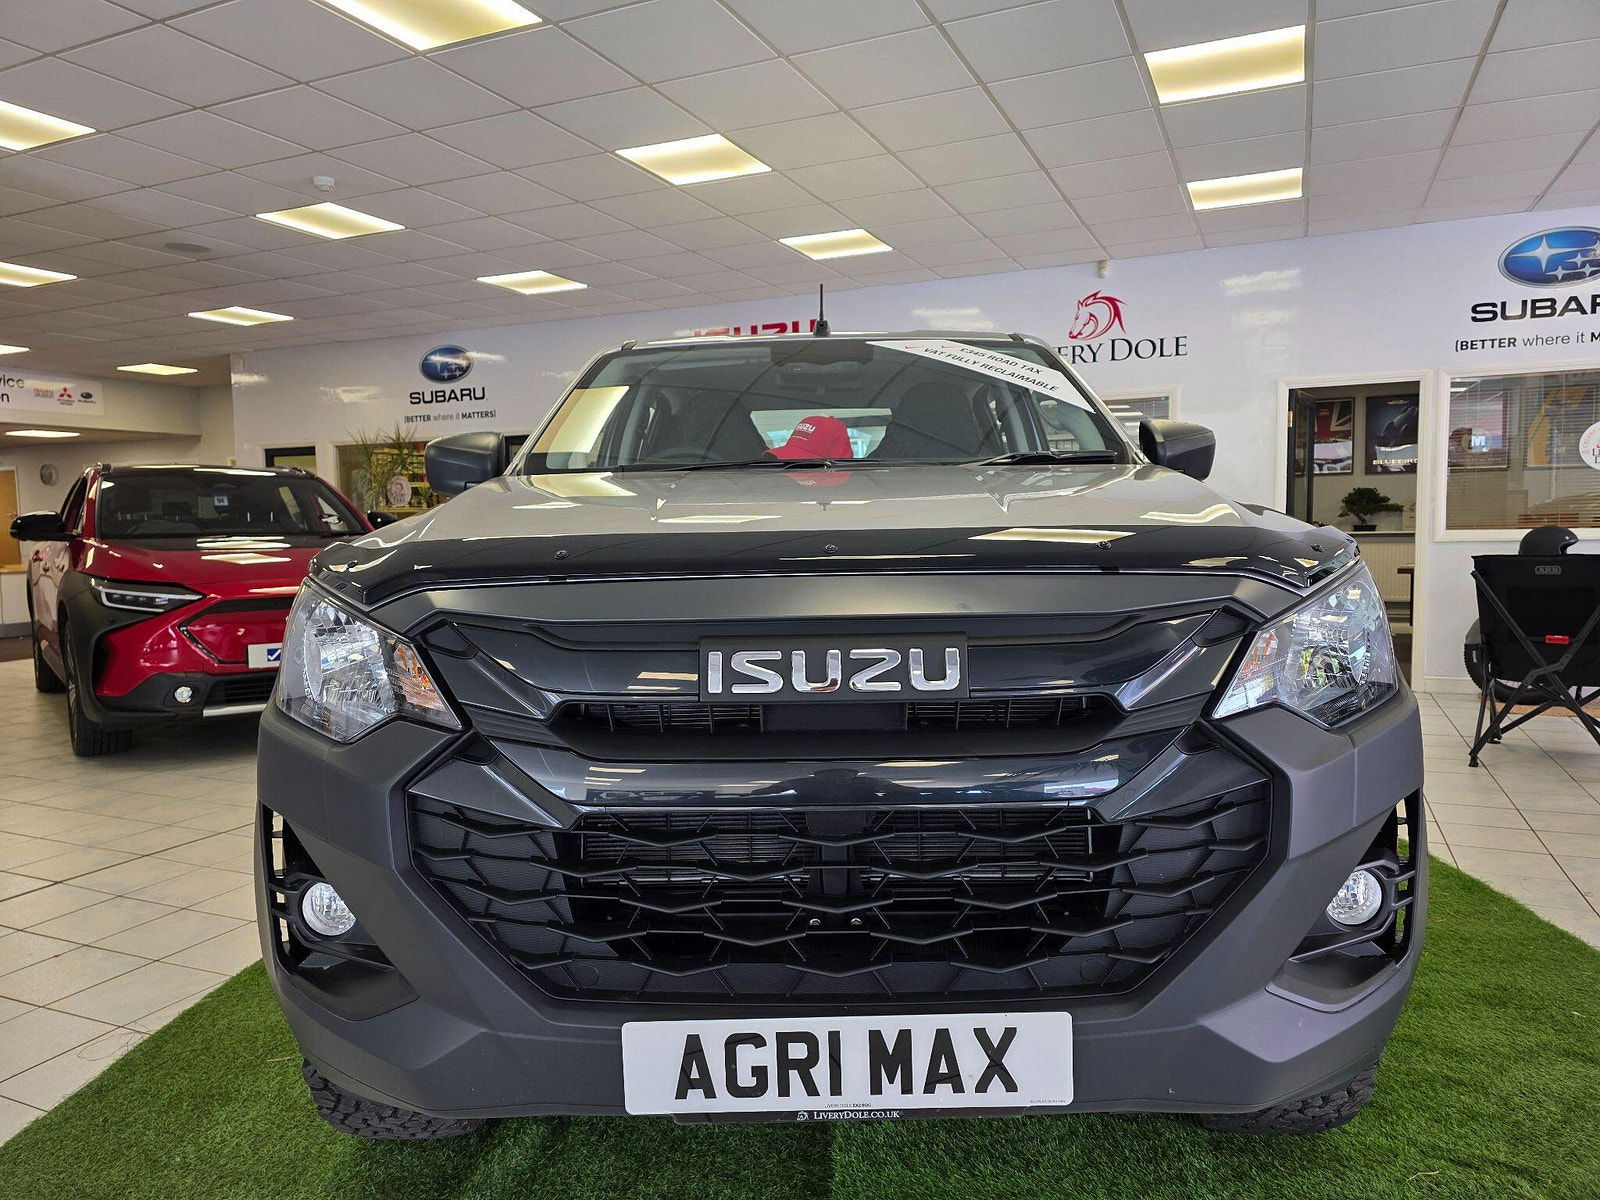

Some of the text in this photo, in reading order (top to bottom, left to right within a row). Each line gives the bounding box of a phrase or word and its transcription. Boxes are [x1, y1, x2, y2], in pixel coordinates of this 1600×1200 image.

[1110, 336, 1188, 362] DOLE
[1522, 335, 1570, 347] where
[1576, 332, 1585, 343] it
[946, 353, 980, 365] FULLY
[980, 363, 1059, 392] RECLAIMABLE
[987, 354, 1018, 367] ROAD
[1020, 364, 1043, 375] TAX
[409, 386, 486, 405] SUBARU
[707, 648, 961, 694] ISUZU
[674, 1026, 1019, 1100] AGRI MAX
[813, 1110, 900, 1120] LIVERYDOLE.CO.UK
